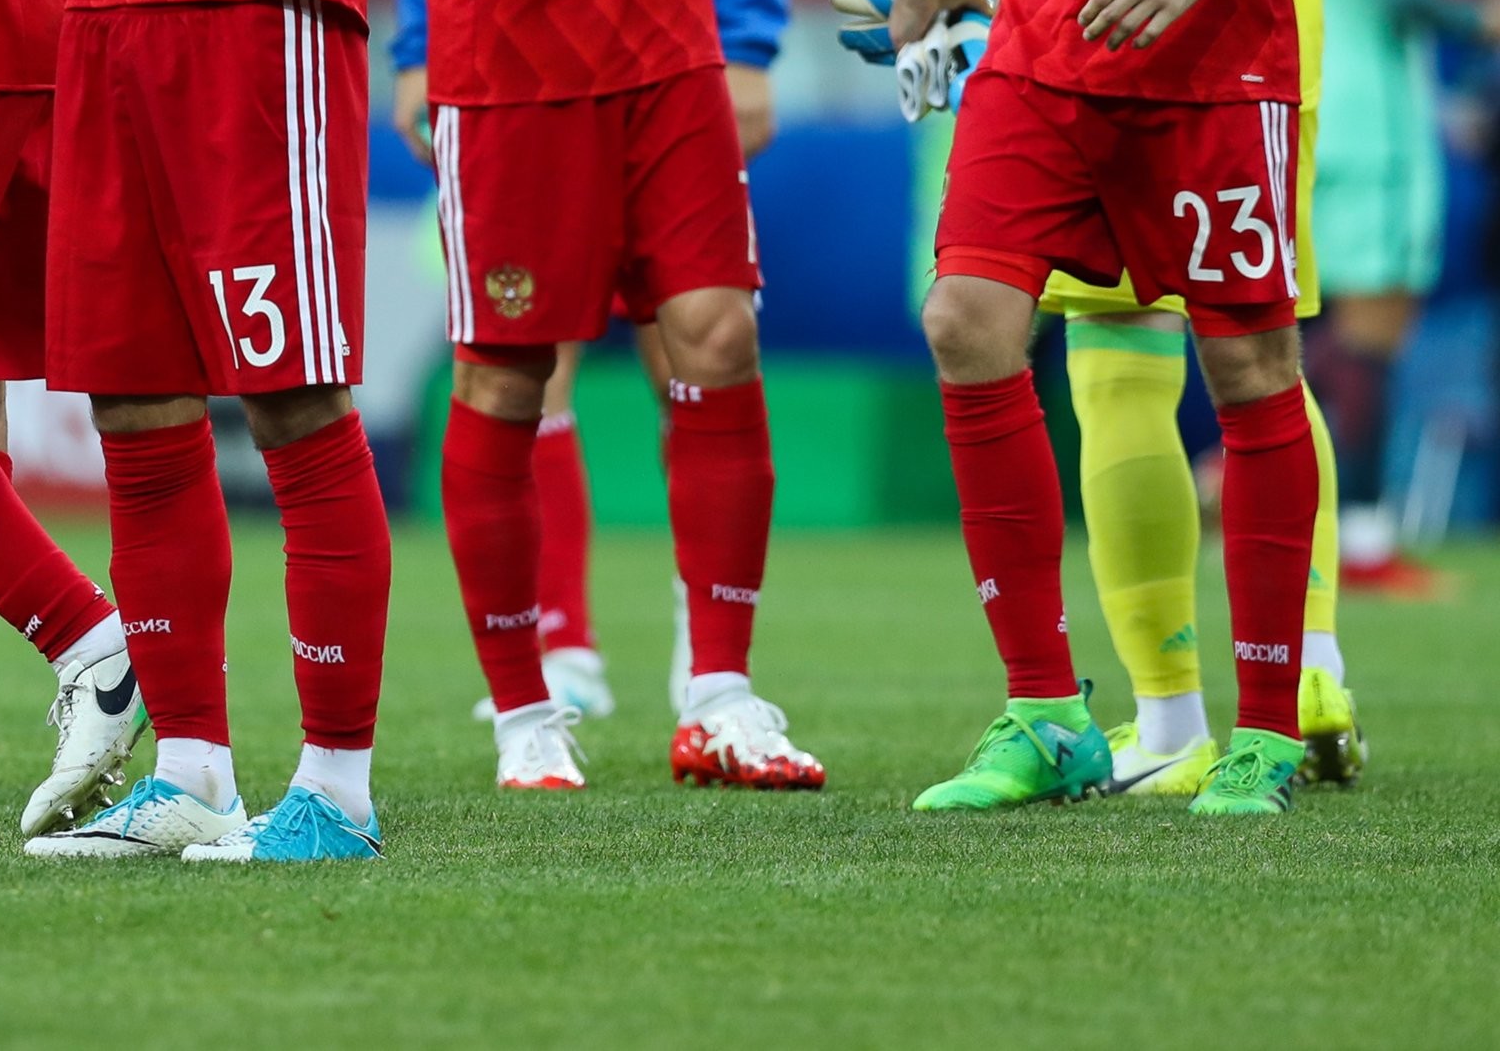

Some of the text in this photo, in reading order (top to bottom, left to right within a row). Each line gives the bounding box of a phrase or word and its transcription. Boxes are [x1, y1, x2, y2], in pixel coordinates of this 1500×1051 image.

[1173, 185, 1275, 282] 23
[209, 264, 285, 369] 13
[122, 618, 171, 636] ССИЯ
[1234, 640, 1289, 664] РОССИЯ
